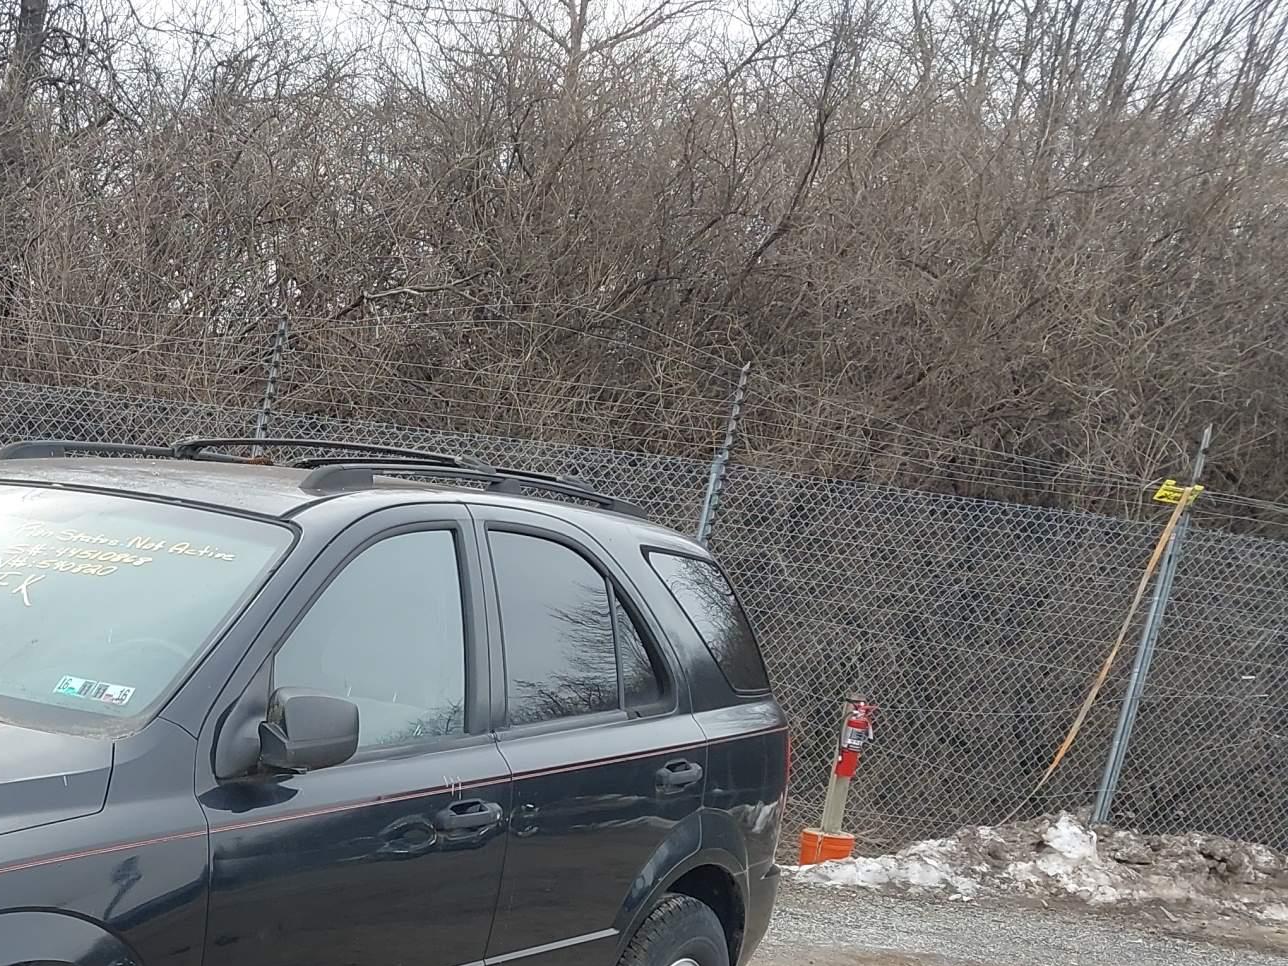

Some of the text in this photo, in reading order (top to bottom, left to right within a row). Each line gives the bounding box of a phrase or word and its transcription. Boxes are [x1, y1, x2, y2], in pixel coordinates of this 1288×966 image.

[56, 546, 153, 567] 44510868
[126, 536, 165, 552] Not
[168, 541, 237, 562] Active
